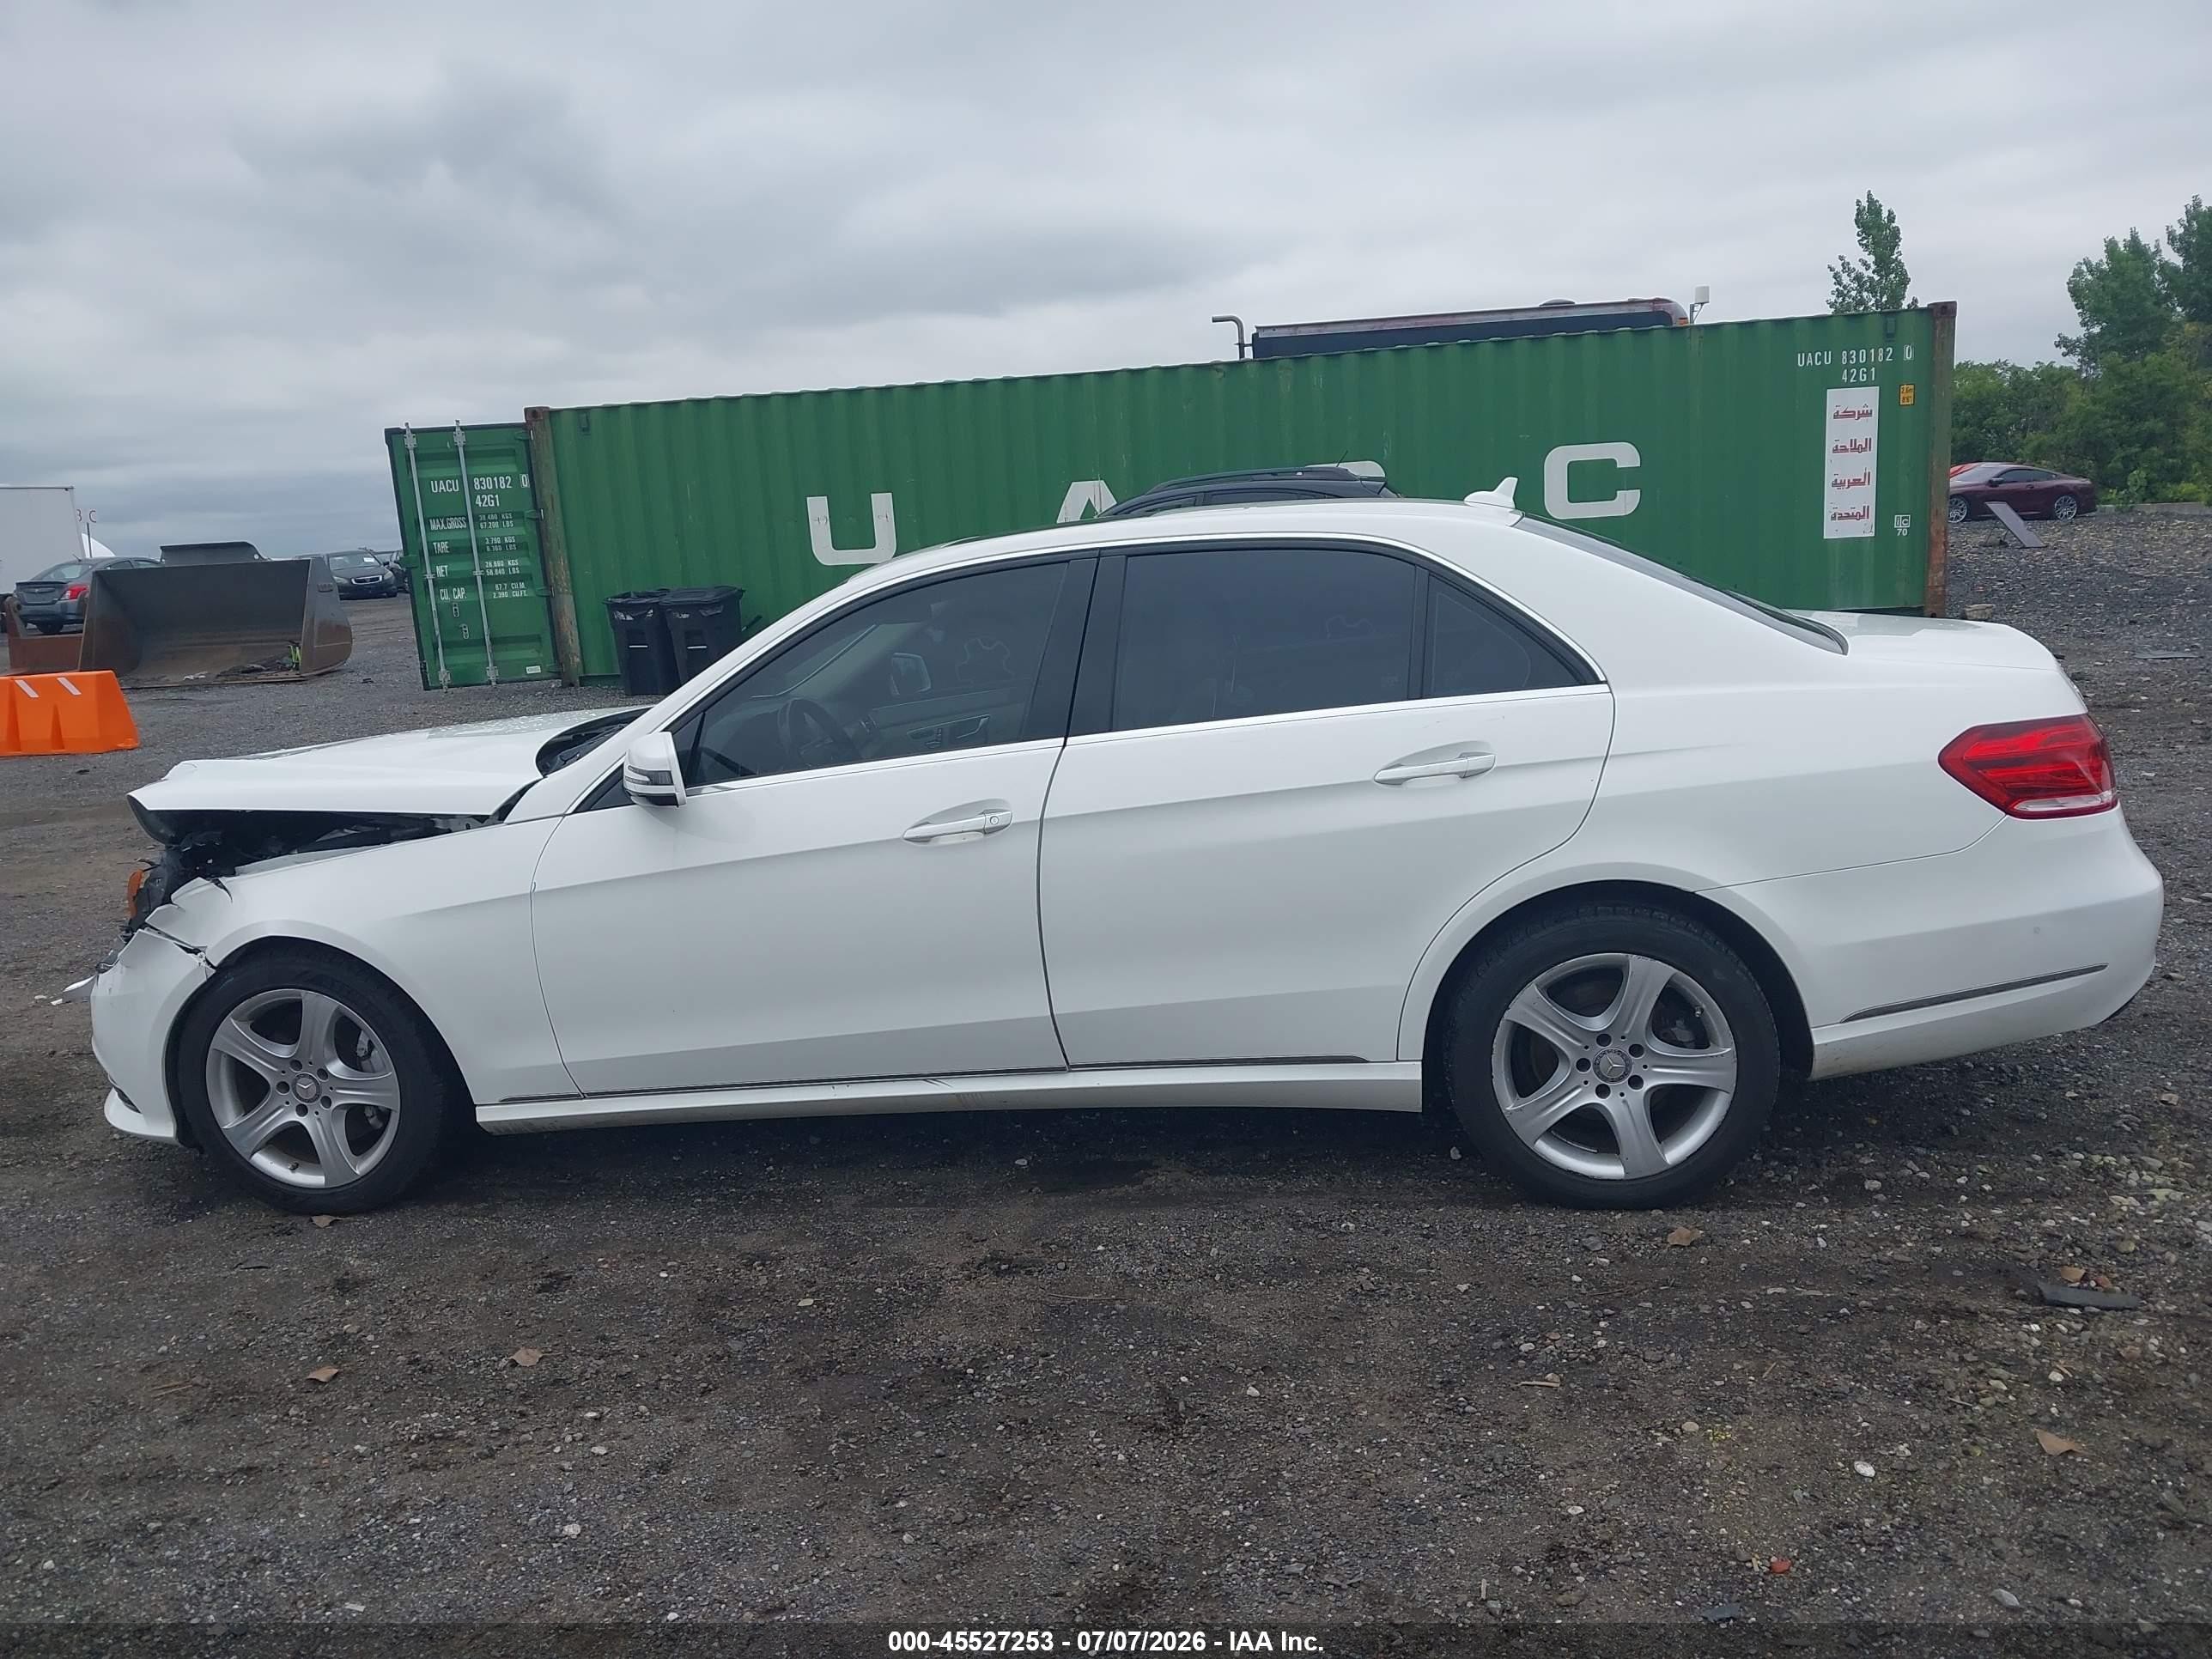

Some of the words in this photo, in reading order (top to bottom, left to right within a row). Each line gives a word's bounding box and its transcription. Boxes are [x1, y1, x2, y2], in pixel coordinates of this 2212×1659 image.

[1797, 351, 1832, 367] UACU
[1842, 347, 1893, 365] 830182
[1842, 367, 1875, 383] 42G1
[1833, 404, 1873, 420] شركة
[1832, 437, 1872, 453] الملاحة
[431, 479, 459, 493] UACU
[474, 476, 513, 490] 830182
[1832, 471, 1871, 489] العربية
[476, 494, 500, 507] 42G1
[1831, 505, 1869, 521] المتحدة
[433, 541, 450, 554] TARE
[435, 565, 448, 578] NET
